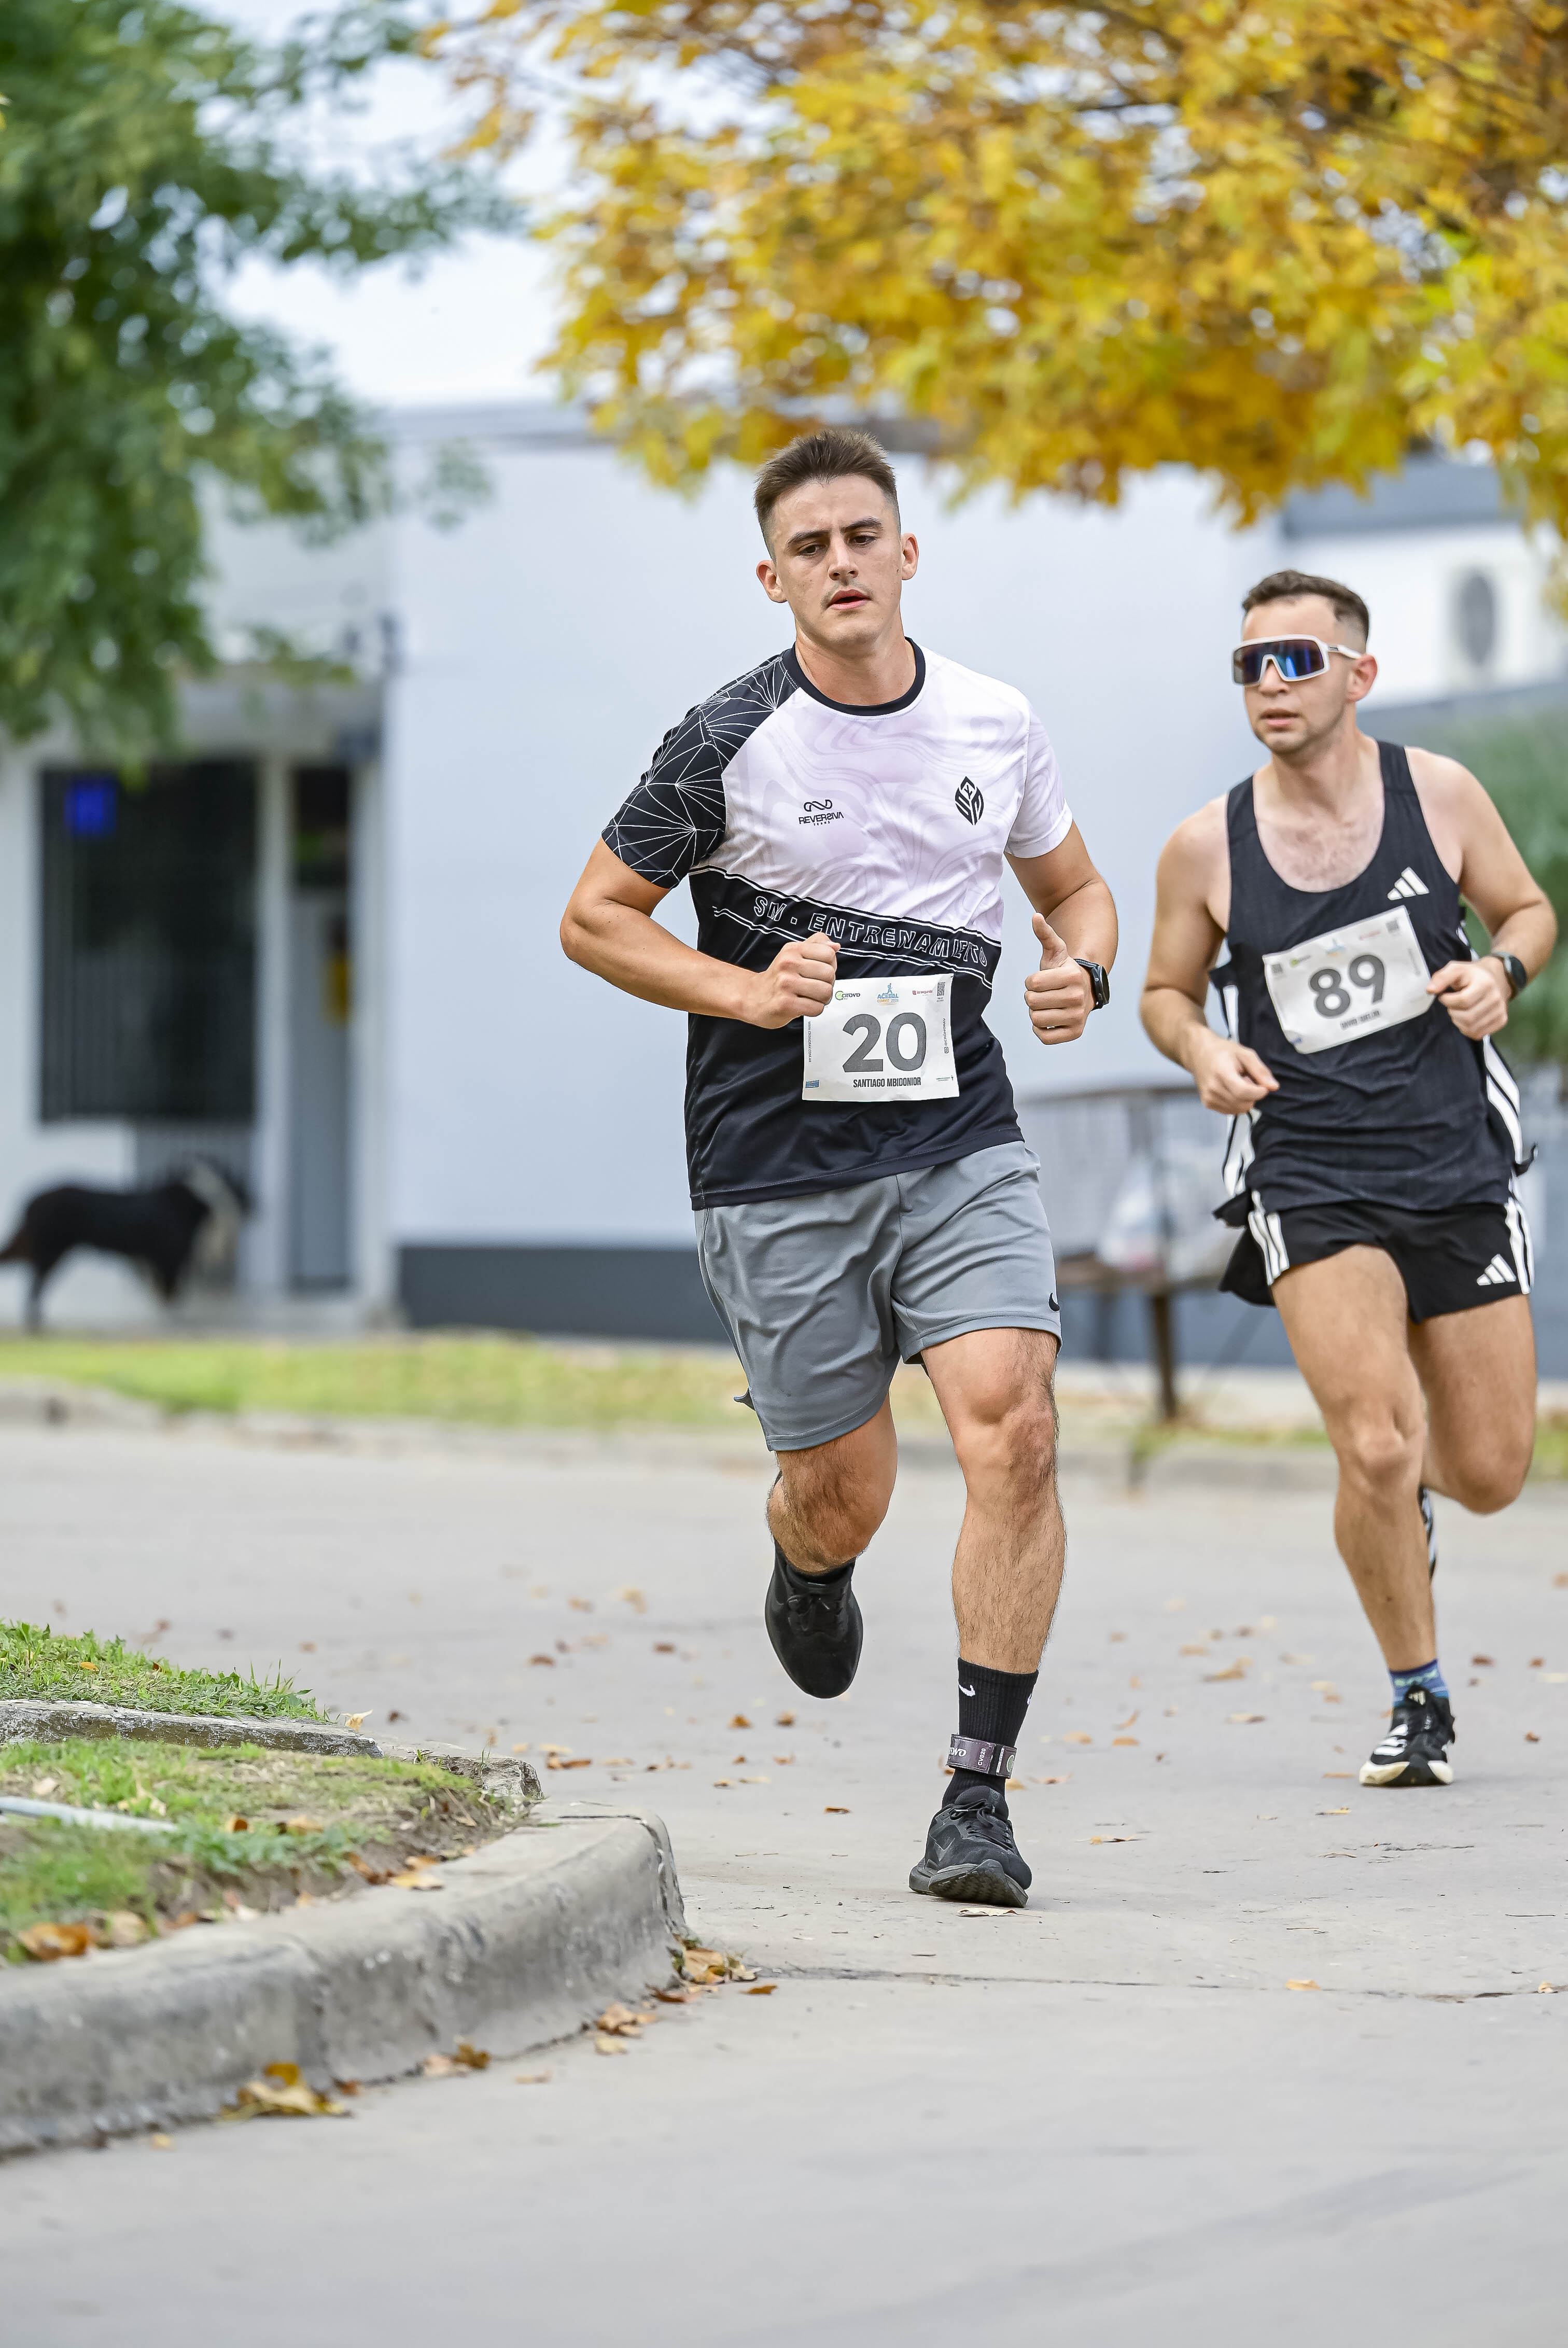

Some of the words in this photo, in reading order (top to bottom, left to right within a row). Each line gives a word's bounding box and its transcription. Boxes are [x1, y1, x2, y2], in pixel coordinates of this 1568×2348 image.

[753, 896, 788, 921] SM
[1310, 954, 1385, 1018] 89
[843, 1012, 927, 1072] 20
[853, 1078, 885, 1088] SANTIAGO
[977, 1748, 986, 1766] CV020
